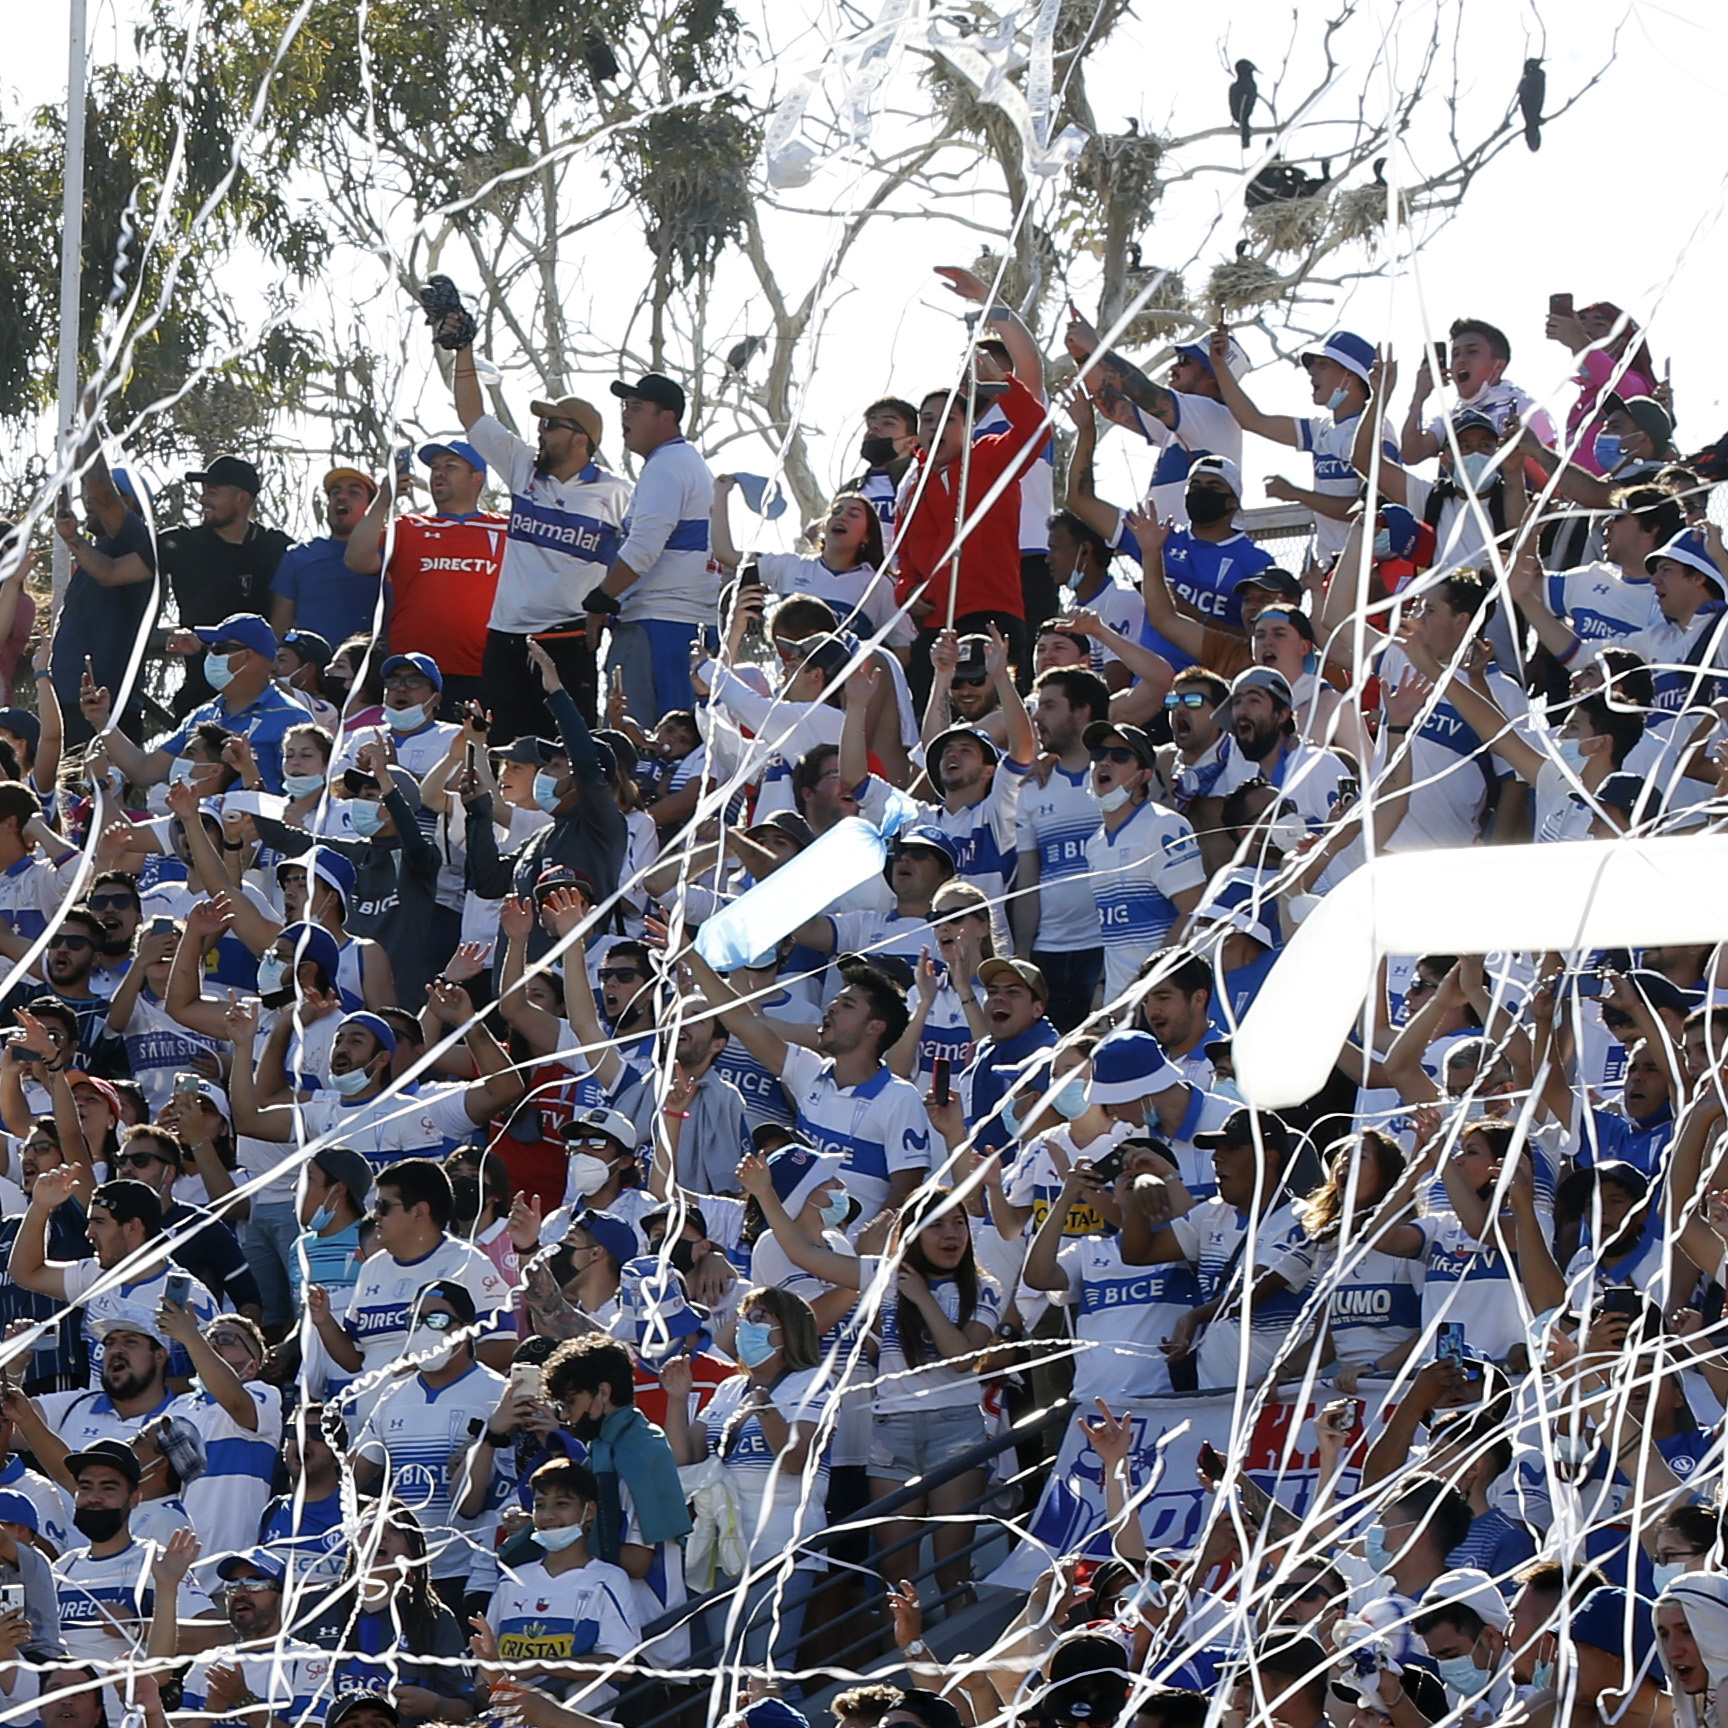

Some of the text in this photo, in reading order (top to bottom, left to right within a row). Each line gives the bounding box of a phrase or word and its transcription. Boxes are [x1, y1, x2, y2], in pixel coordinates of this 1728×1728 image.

[511, 512, 602, 552] parmalat
[419, 557, 496, 575] DIRECTV
[358, 895, 399, 914] BICE
[1104, 1278, 1164, 1304] BICE
